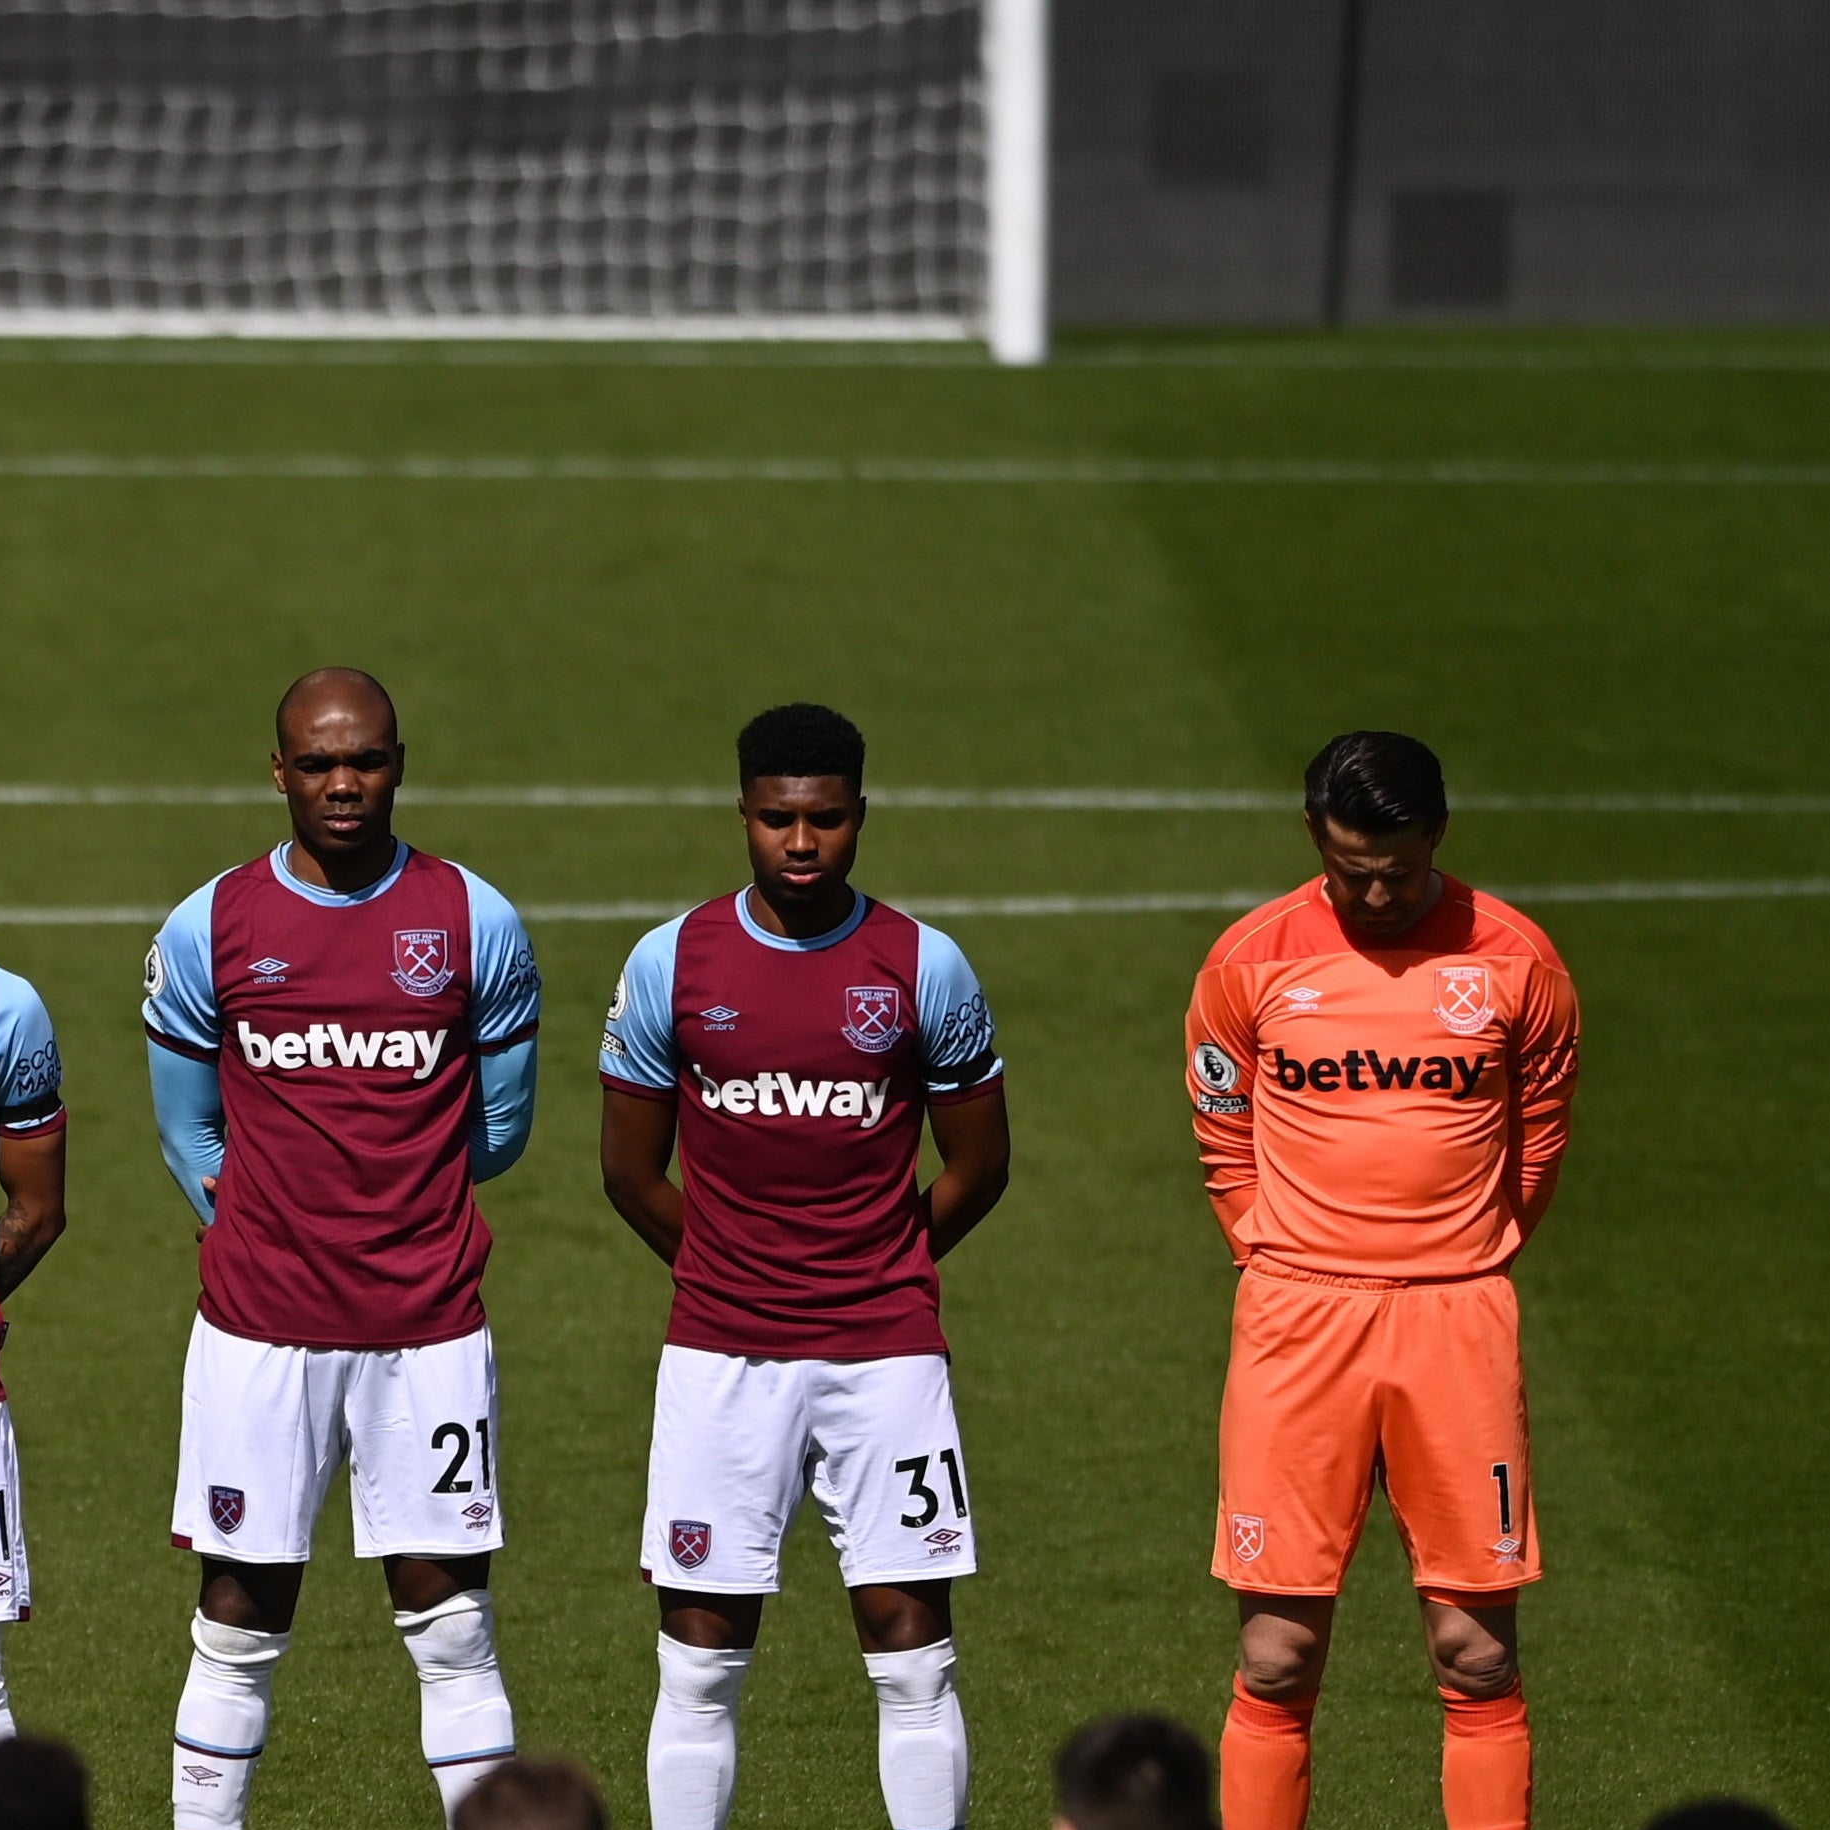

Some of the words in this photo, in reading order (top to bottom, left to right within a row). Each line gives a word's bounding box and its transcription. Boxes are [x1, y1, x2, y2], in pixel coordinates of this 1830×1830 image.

[253, 975, 286, 983] umbro
[238, 1021, 448, 1079] betway
[703, 1023, 736, 1031] umbro
[693, 1064, 890, 1128] betway
[1274, 1048, 1487, 1099] betway
[431, 1418, 490, 1493] 21
[894, 1448, 967, 1528] 31
[1491, 1463, 1512, 1534] 1
[929, 1545, 960, 1555] umbro
